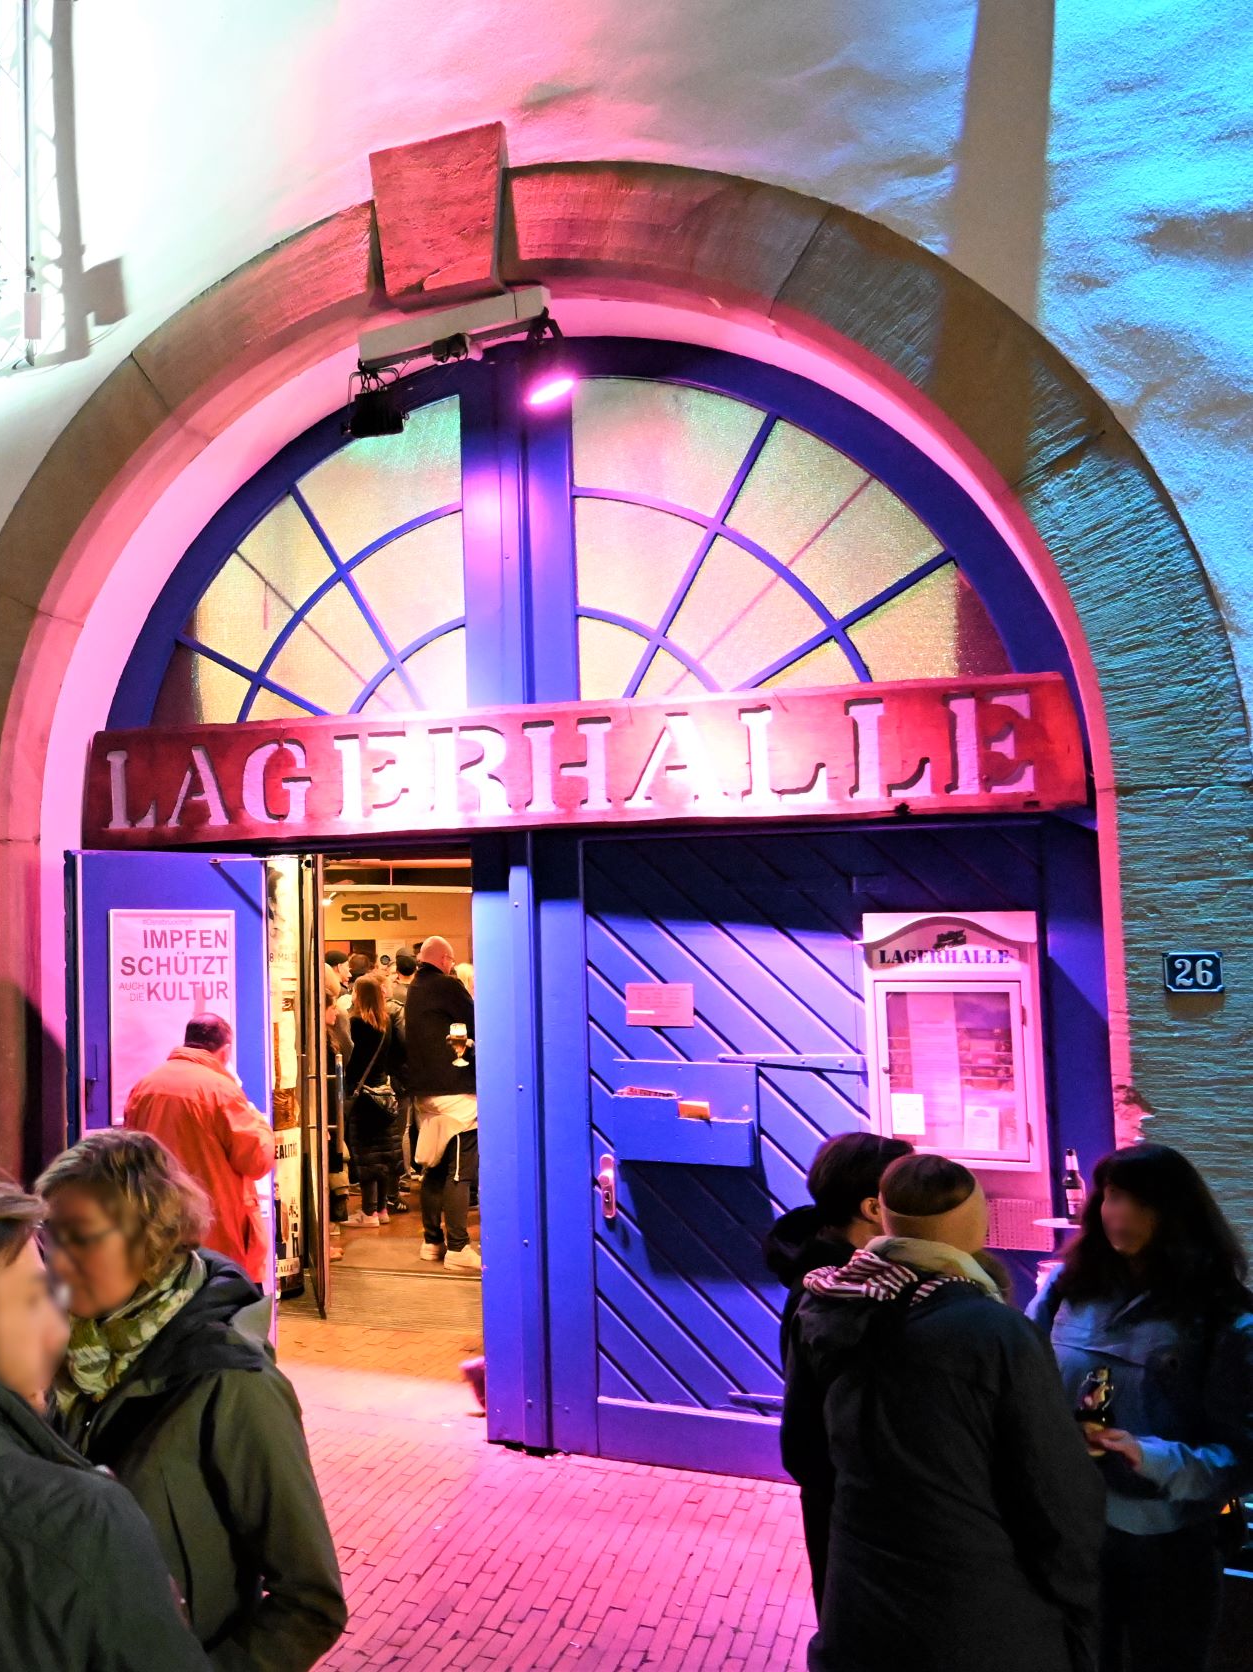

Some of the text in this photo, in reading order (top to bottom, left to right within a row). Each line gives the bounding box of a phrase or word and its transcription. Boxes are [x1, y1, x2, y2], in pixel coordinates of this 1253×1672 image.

[105, 690, 1036, 830] LAGERHALLE
[143, 929, 227, 949] IMPFEN
[120, 951, 229, 976] SCHÜTZT
[879, 949, 1010, 964] LAGERHALLE
[1174, 958, 1214, 987] 26
[119, 982, 145, 991] AUCH
[147, 981, 229, 1001] KULTUR
[129, 993, 145, 1002] DIE
